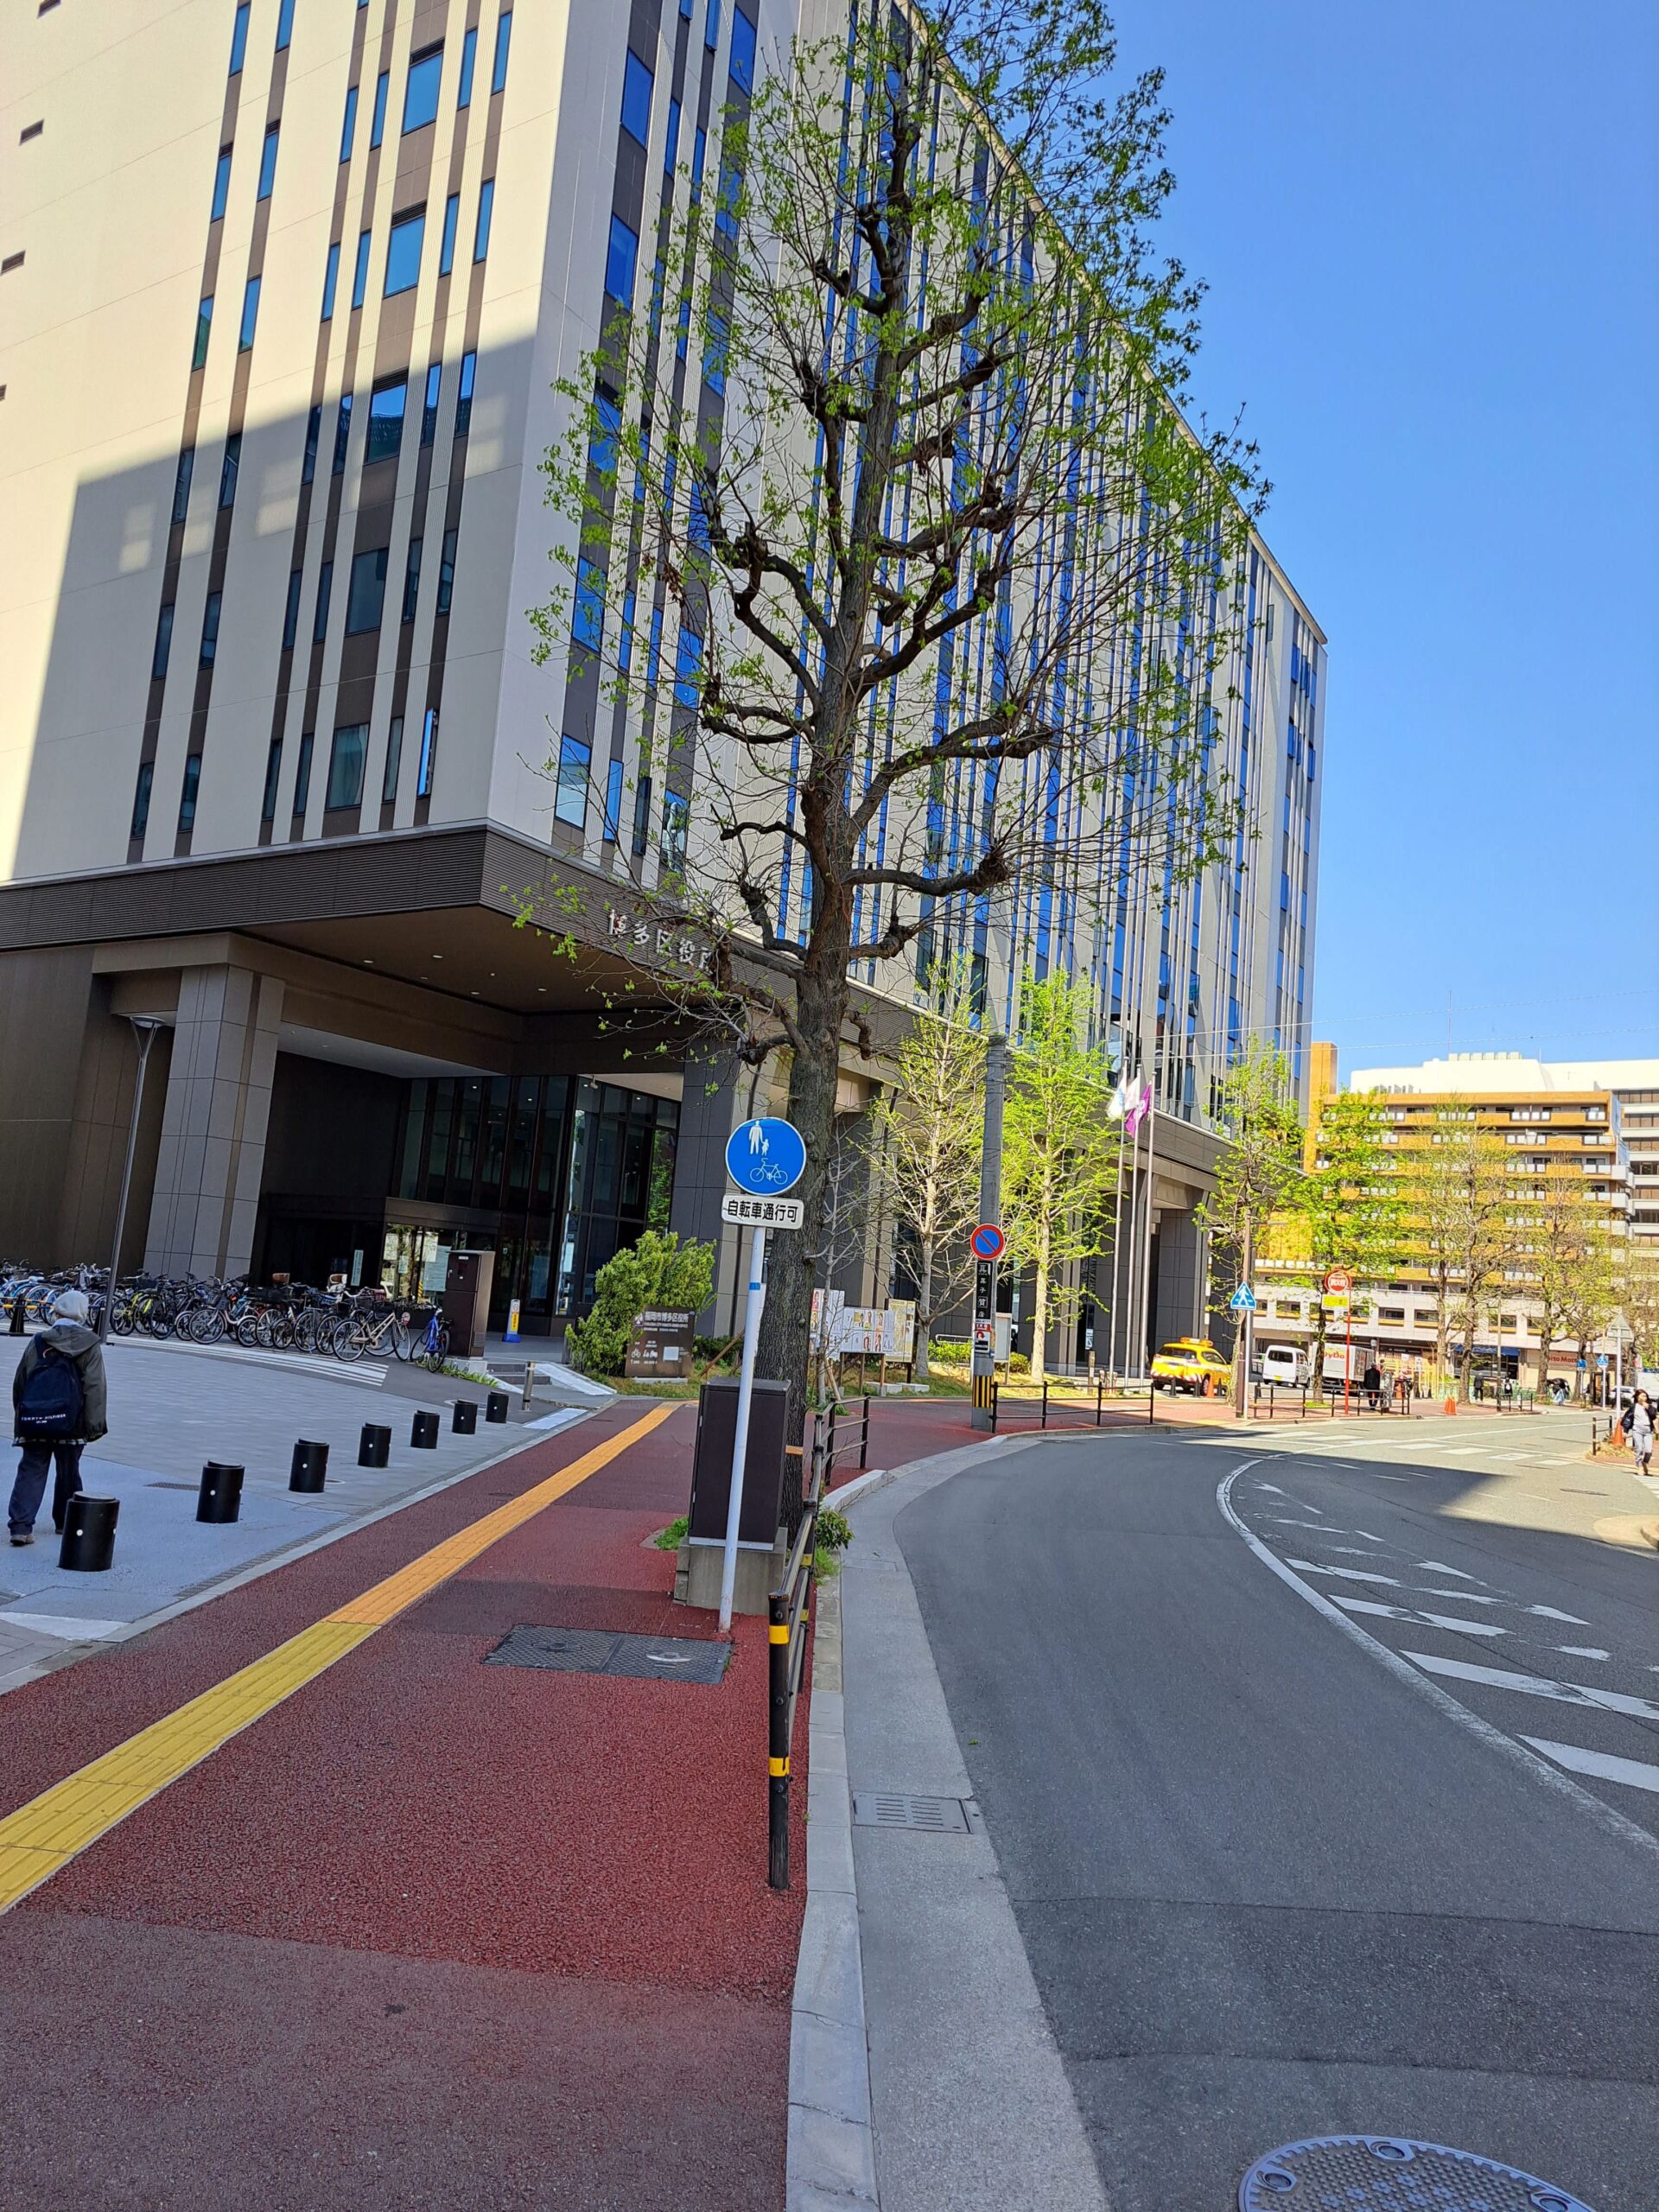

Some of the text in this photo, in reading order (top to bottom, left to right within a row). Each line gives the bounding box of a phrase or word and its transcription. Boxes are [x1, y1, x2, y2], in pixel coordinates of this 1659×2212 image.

[728, 1199, 799, 1223] 自転車通行可
[645, 1311, 690, 1323] 福岡市博多区役所
